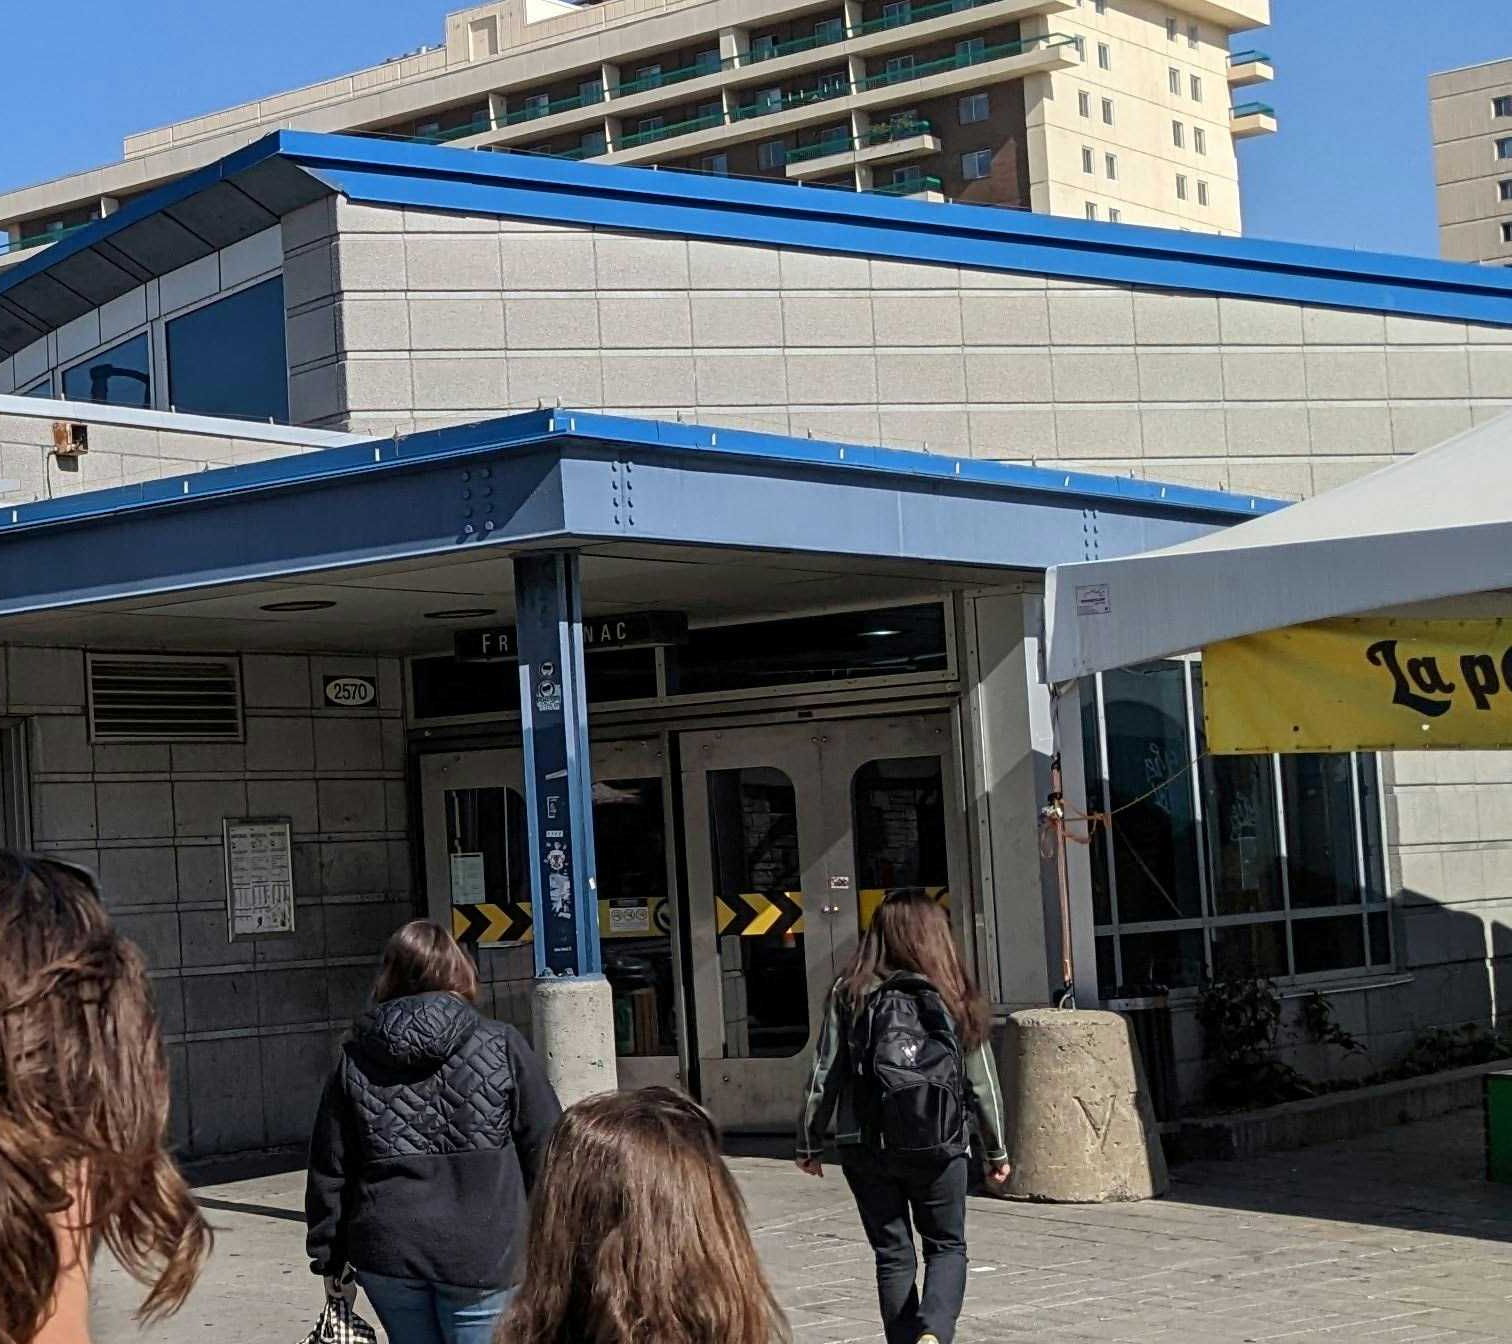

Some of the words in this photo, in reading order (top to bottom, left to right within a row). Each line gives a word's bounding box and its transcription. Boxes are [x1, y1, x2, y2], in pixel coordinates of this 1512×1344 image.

[482, 622, 626, 654] FRNAC
[333, 682, 367, 700] 2570
[1366, 640, 1456, 717] La
